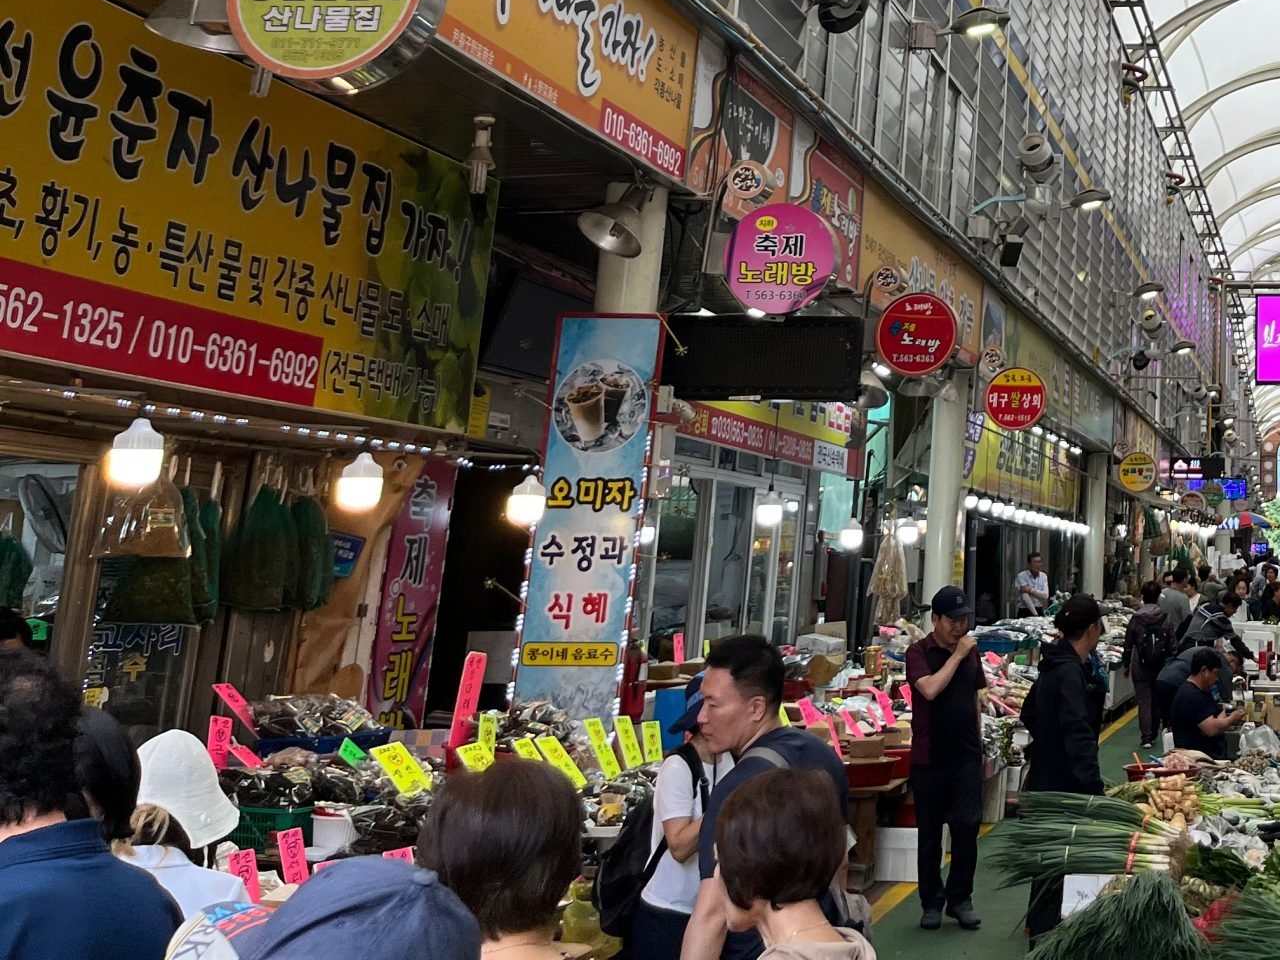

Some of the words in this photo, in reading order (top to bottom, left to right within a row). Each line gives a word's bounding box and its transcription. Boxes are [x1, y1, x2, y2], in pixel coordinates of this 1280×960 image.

[262, 6, 382, 33] 산나물집
[46, 22, 220, 188] 윤춘자
[231, 117, 393, 257] 산나물집
[400, 199, 471, 284] 가자!
[603, 106, 683, 176] 010-6361-6992
[34, 179, 103, 262] 황기,
[758, 218, 775, 229] 지하
[754, 233, 805, 258] 축제
[737, 261, 817, 286] 노래방
[148, 317, 321, 391] 010-6361-6992
[900, 332, 941, 353] 노래방
[988, 391, 1042, 409] 대구쌀상회
[546, 476, 638, 512] 오미자
[388, 475, 436, 586] 축제
[540, 534, 629, 572] 수정과
[547, 592, 610, 630] 식혜
[571, 647, 614, 663] 음료수
